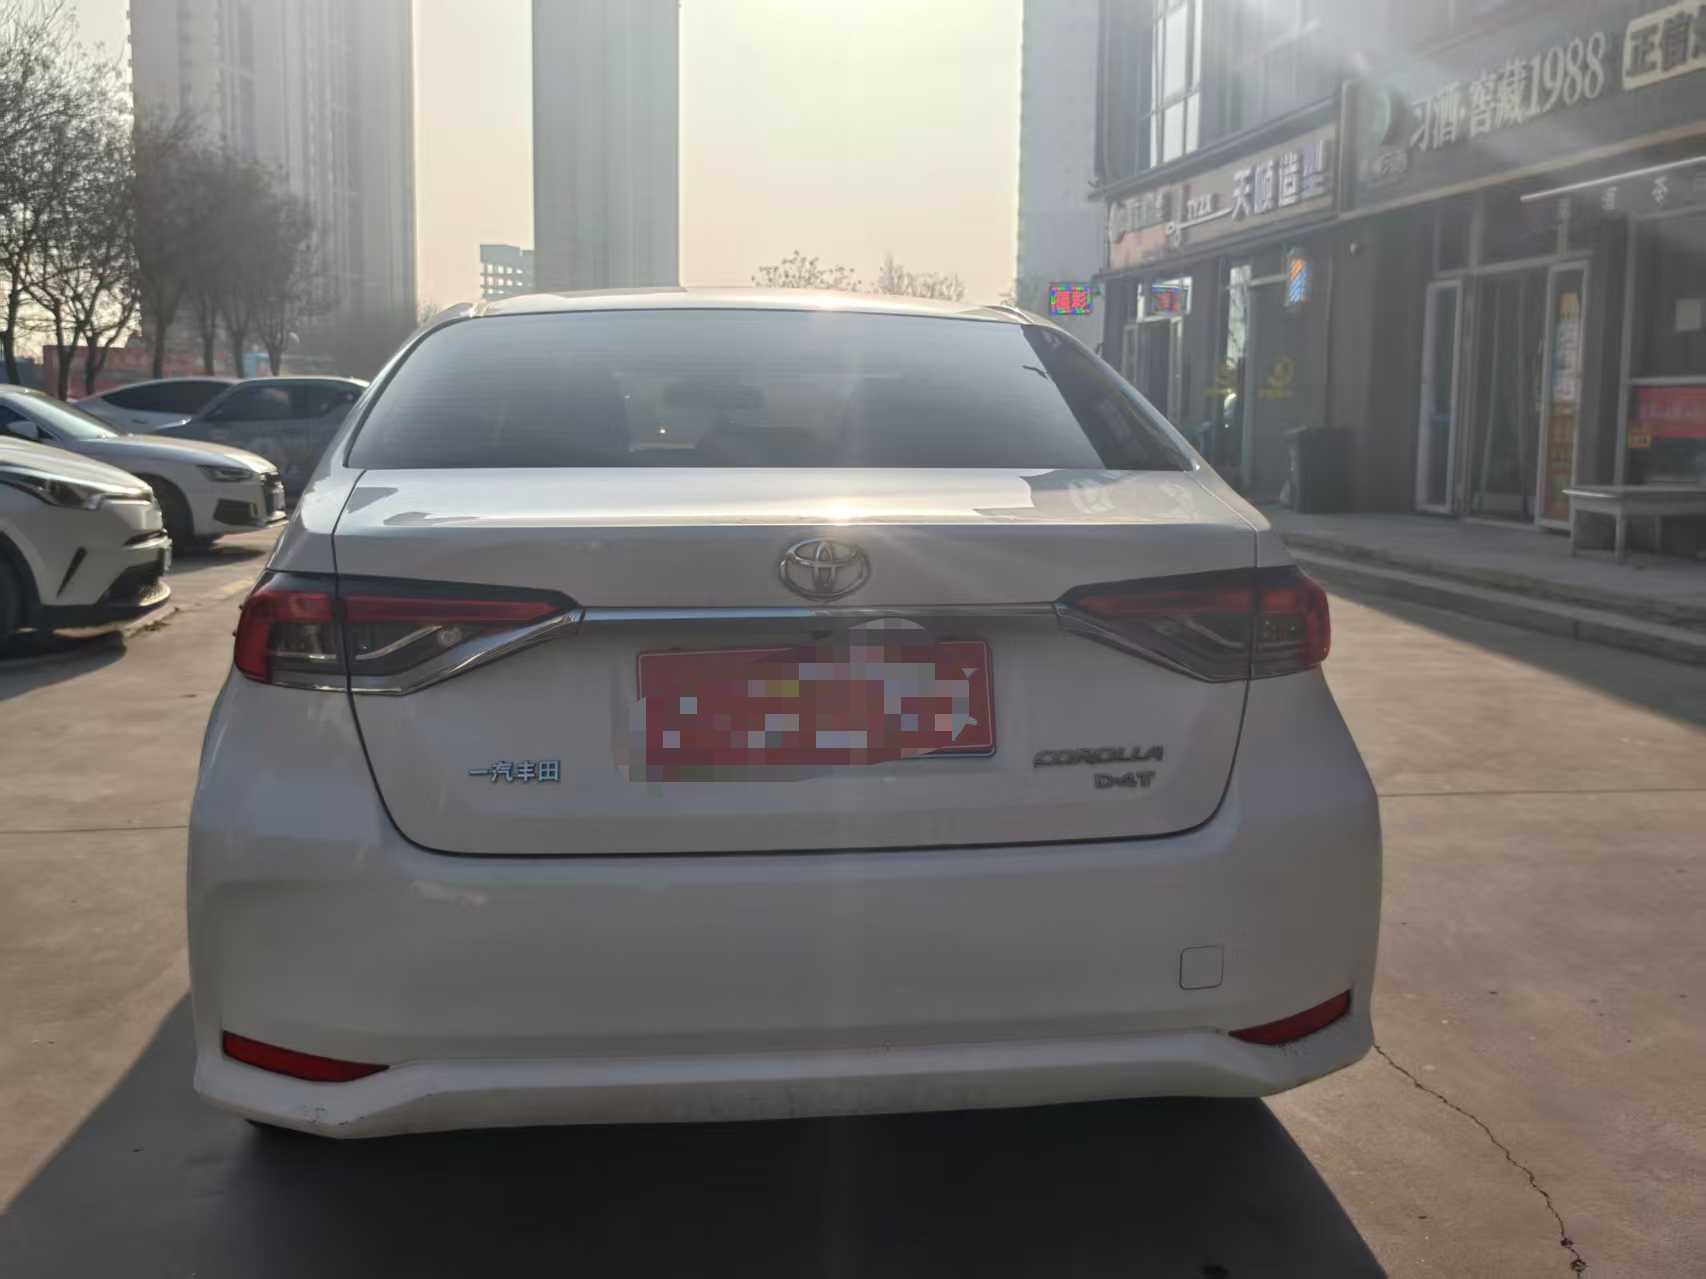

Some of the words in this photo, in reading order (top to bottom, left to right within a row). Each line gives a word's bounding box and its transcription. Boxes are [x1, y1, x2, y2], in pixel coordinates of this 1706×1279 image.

[1032, 744, 1164, 768] COROLLA
[466, 760, 560, 783] 一汽丰田
